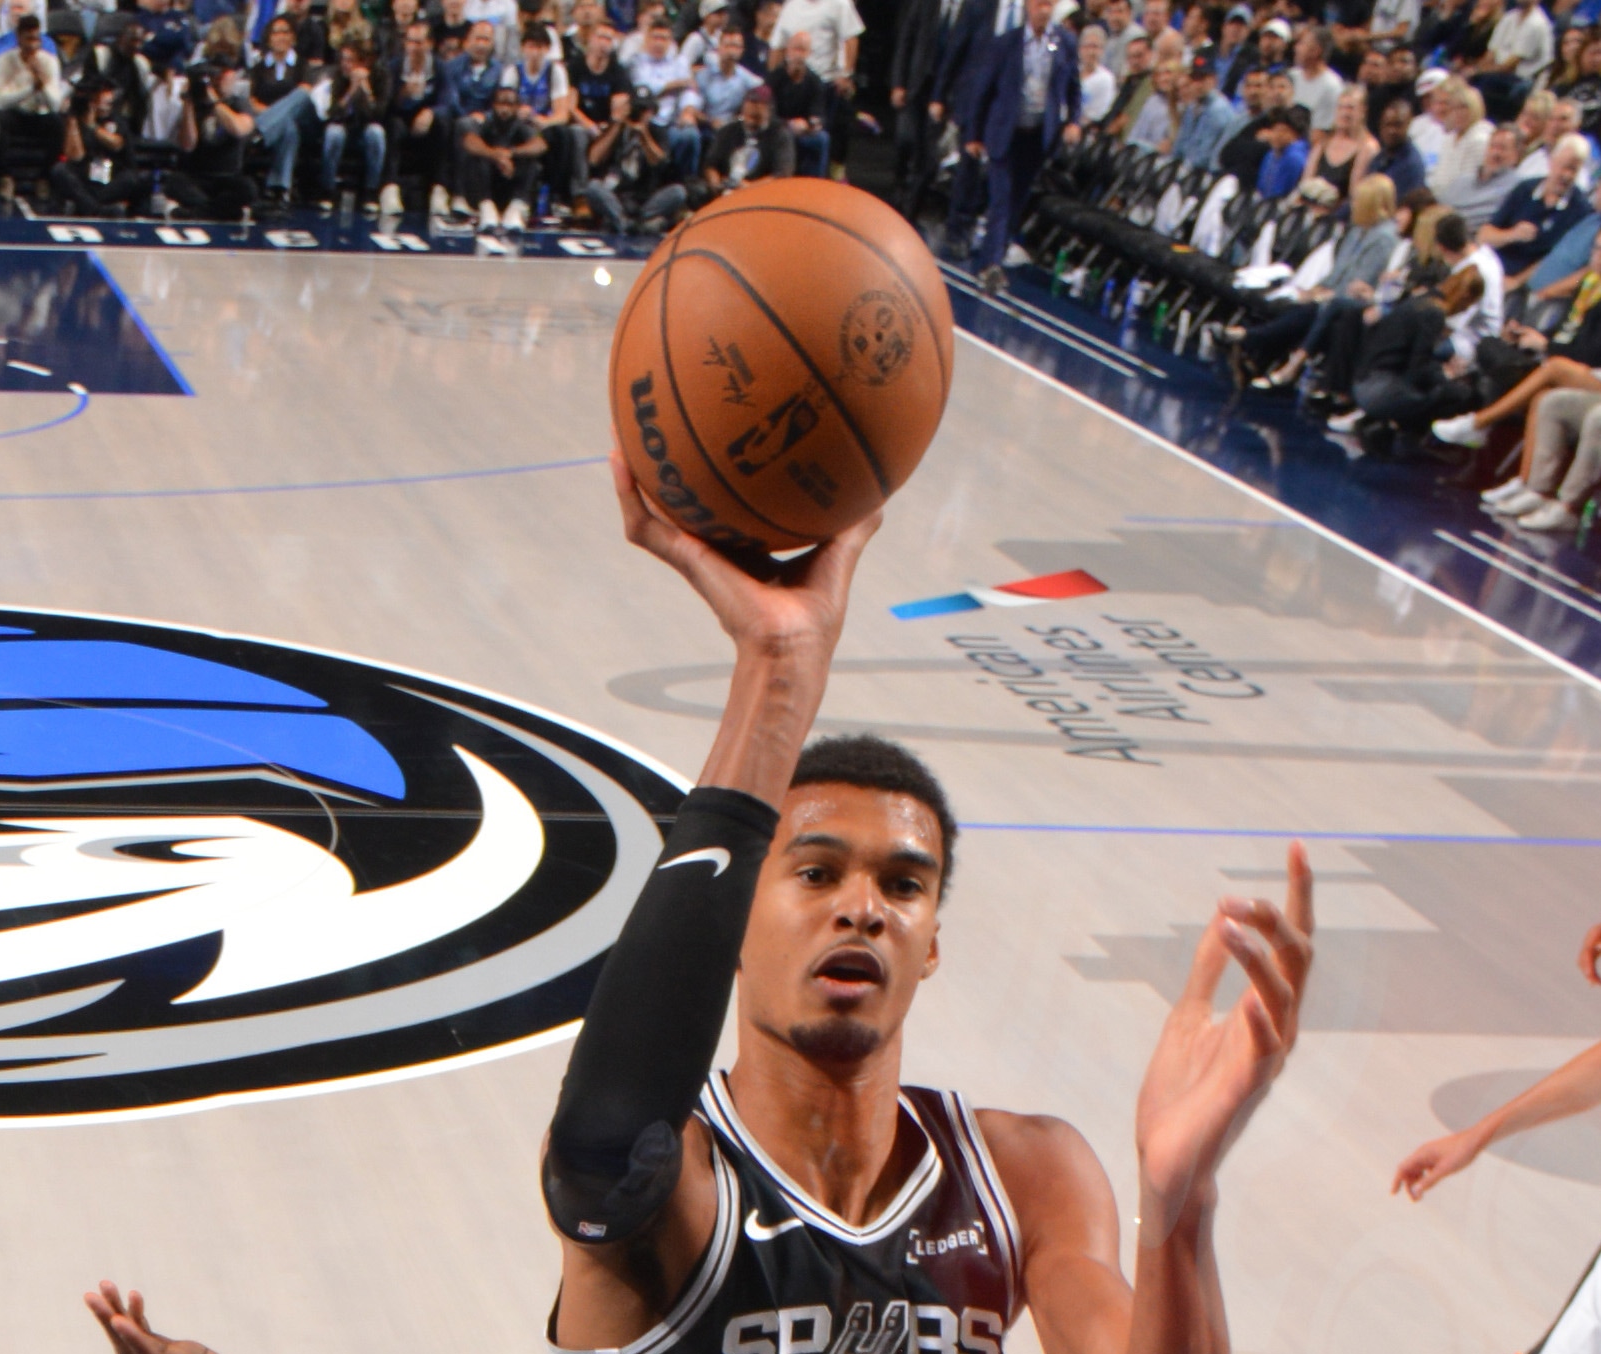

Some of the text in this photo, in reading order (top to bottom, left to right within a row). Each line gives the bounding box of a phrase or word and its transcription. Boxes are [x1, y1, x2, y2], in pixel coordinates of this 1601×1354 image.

[944, 635, 1164, 767] American
[1023, 624, 1213, 726] Airlines
[1101, 612, 1267, 700] Center
[913, 1228, 980, 1257] LEDGER
